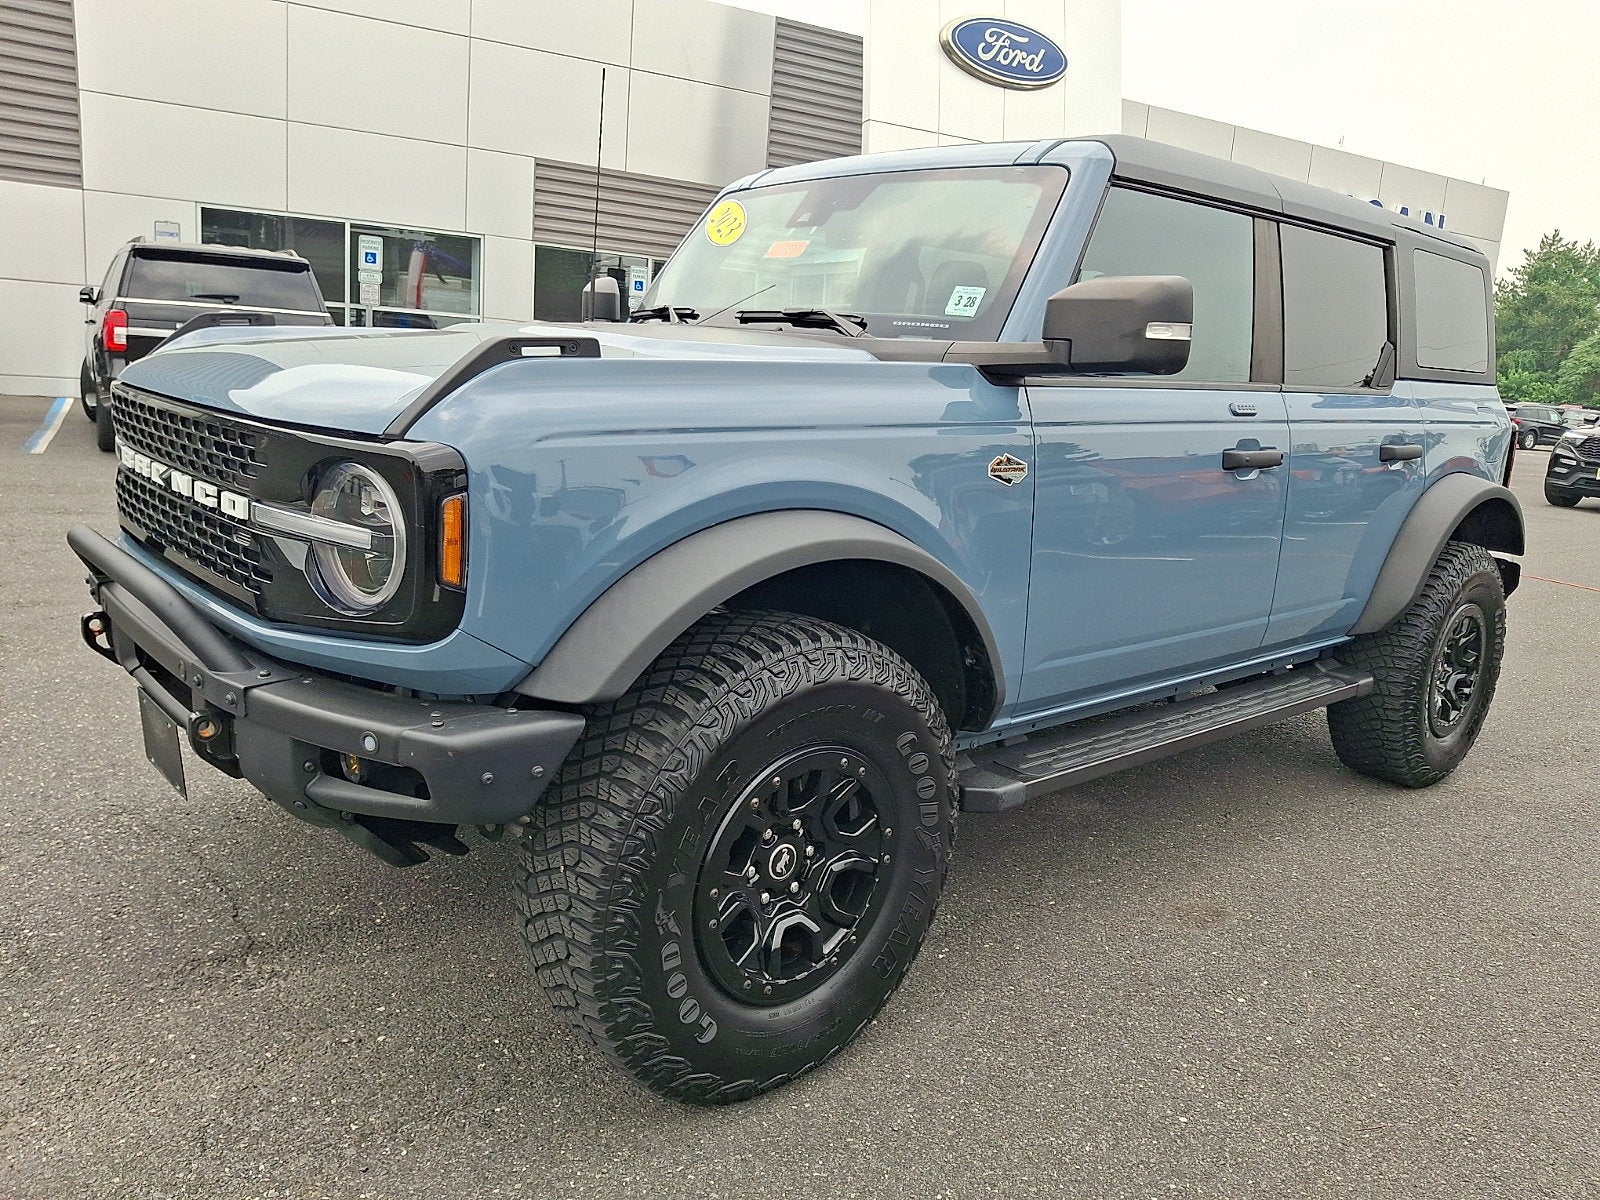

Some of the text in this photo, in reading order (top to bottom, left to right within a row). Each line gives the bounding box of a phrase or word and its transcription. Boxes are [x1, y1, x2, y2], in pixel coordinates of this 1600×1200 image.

[977, 27, 1046, 73] Ford
[954, 294, 978, 308] 3 28
